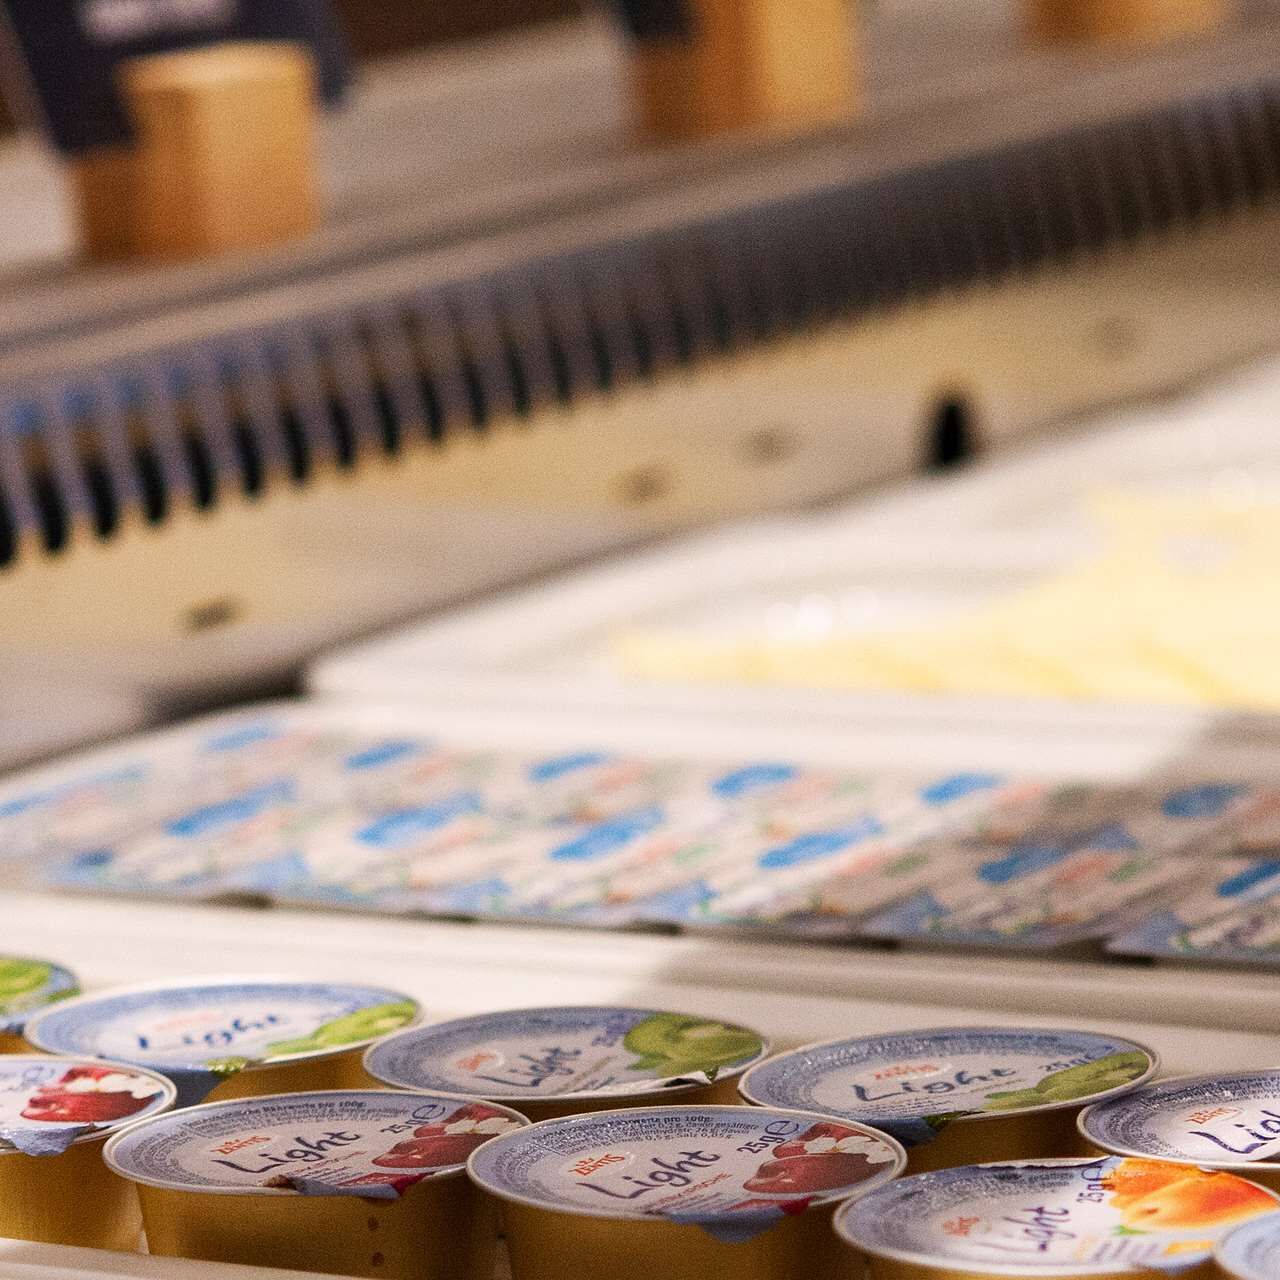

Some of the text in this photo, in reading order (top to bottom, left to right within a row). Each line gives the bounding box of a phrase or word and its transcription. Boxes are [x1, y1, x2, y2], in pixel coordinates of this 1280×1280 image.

[852, 1068, 1017, 1101] Light
[380, 1117, 428, 1135] 25g
[211, 1131, 361, 1174] Light
[736, 1135, 786, 1154] 25g
[576, 1150, 721, 1200] Light
[1076, 1183, 1115, 1203] 25g
[974, 1206, 1077, 1253] Light
